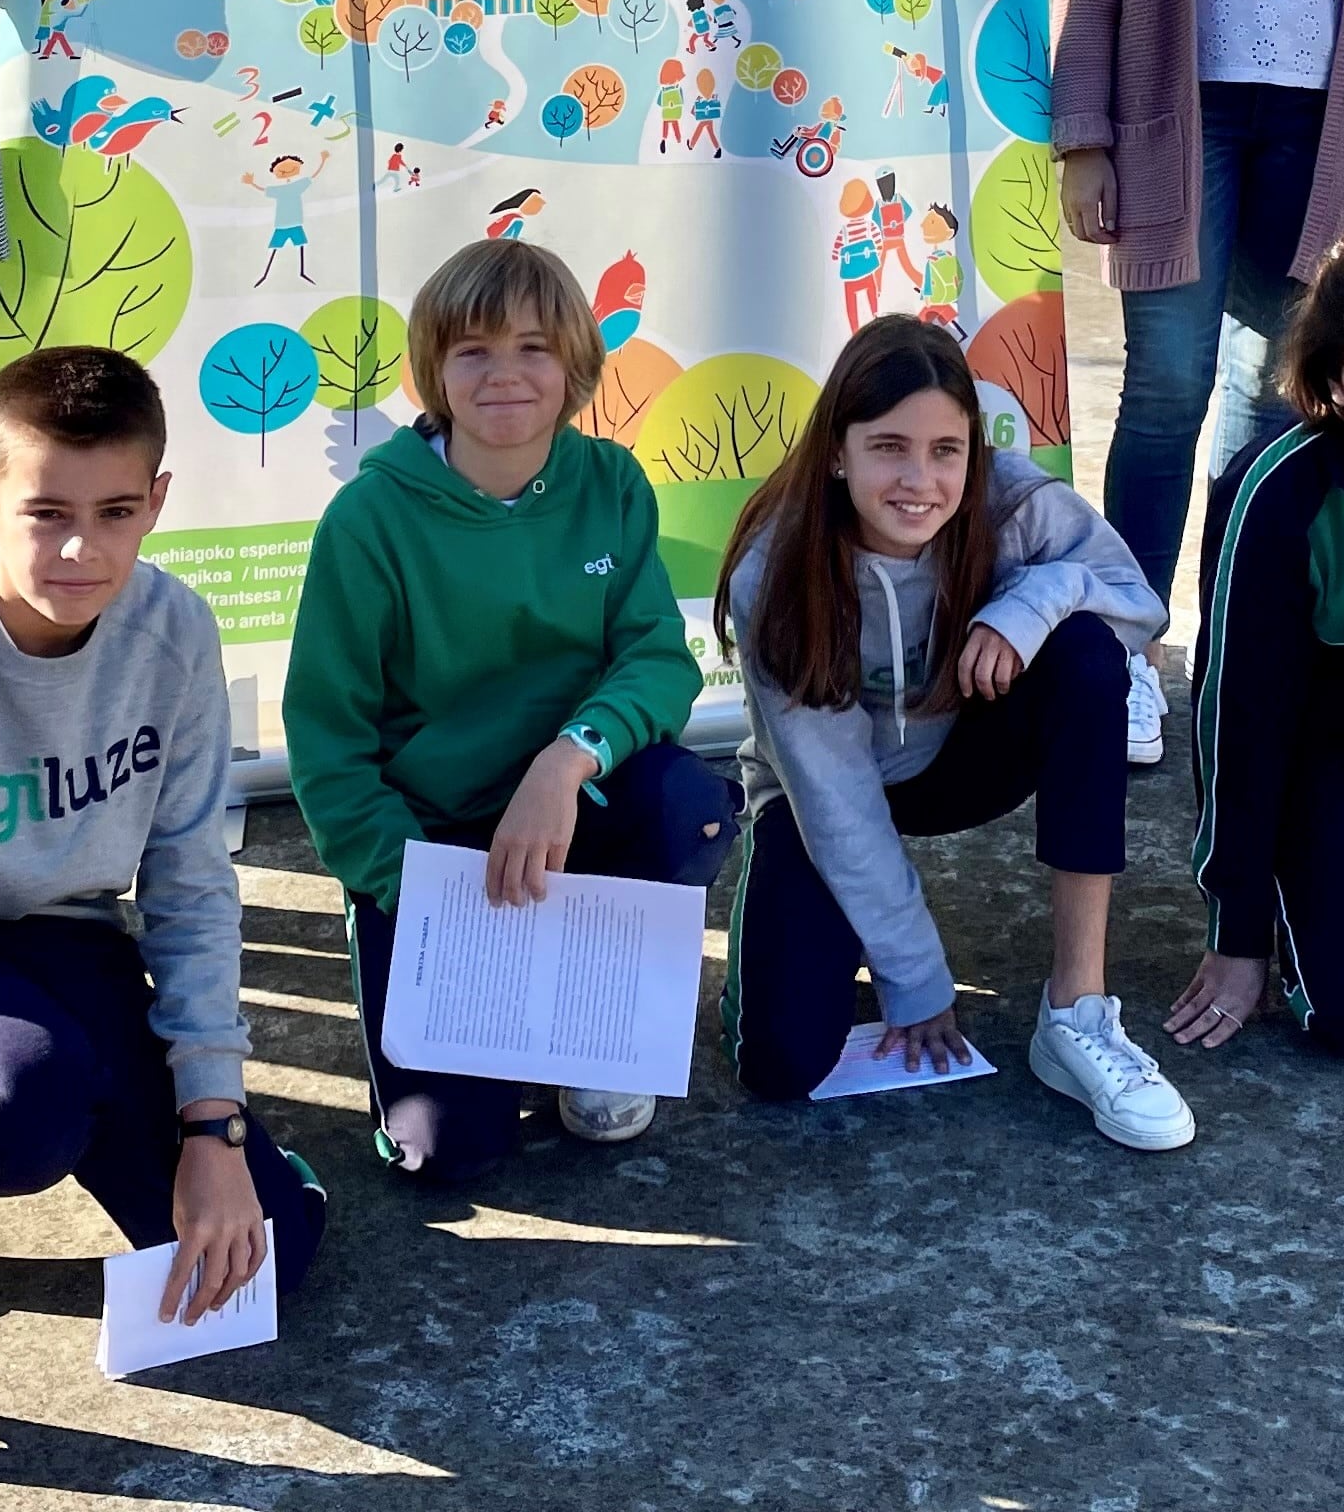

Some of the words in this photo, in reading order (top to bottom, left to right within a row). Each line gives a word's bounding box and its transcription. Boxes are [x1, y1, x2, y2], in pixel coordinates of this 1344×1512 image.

[252, 111, 273, 146] 2
[206, 589, 281, 607] frantsesa
[239, 611, 285, 629] arreta
